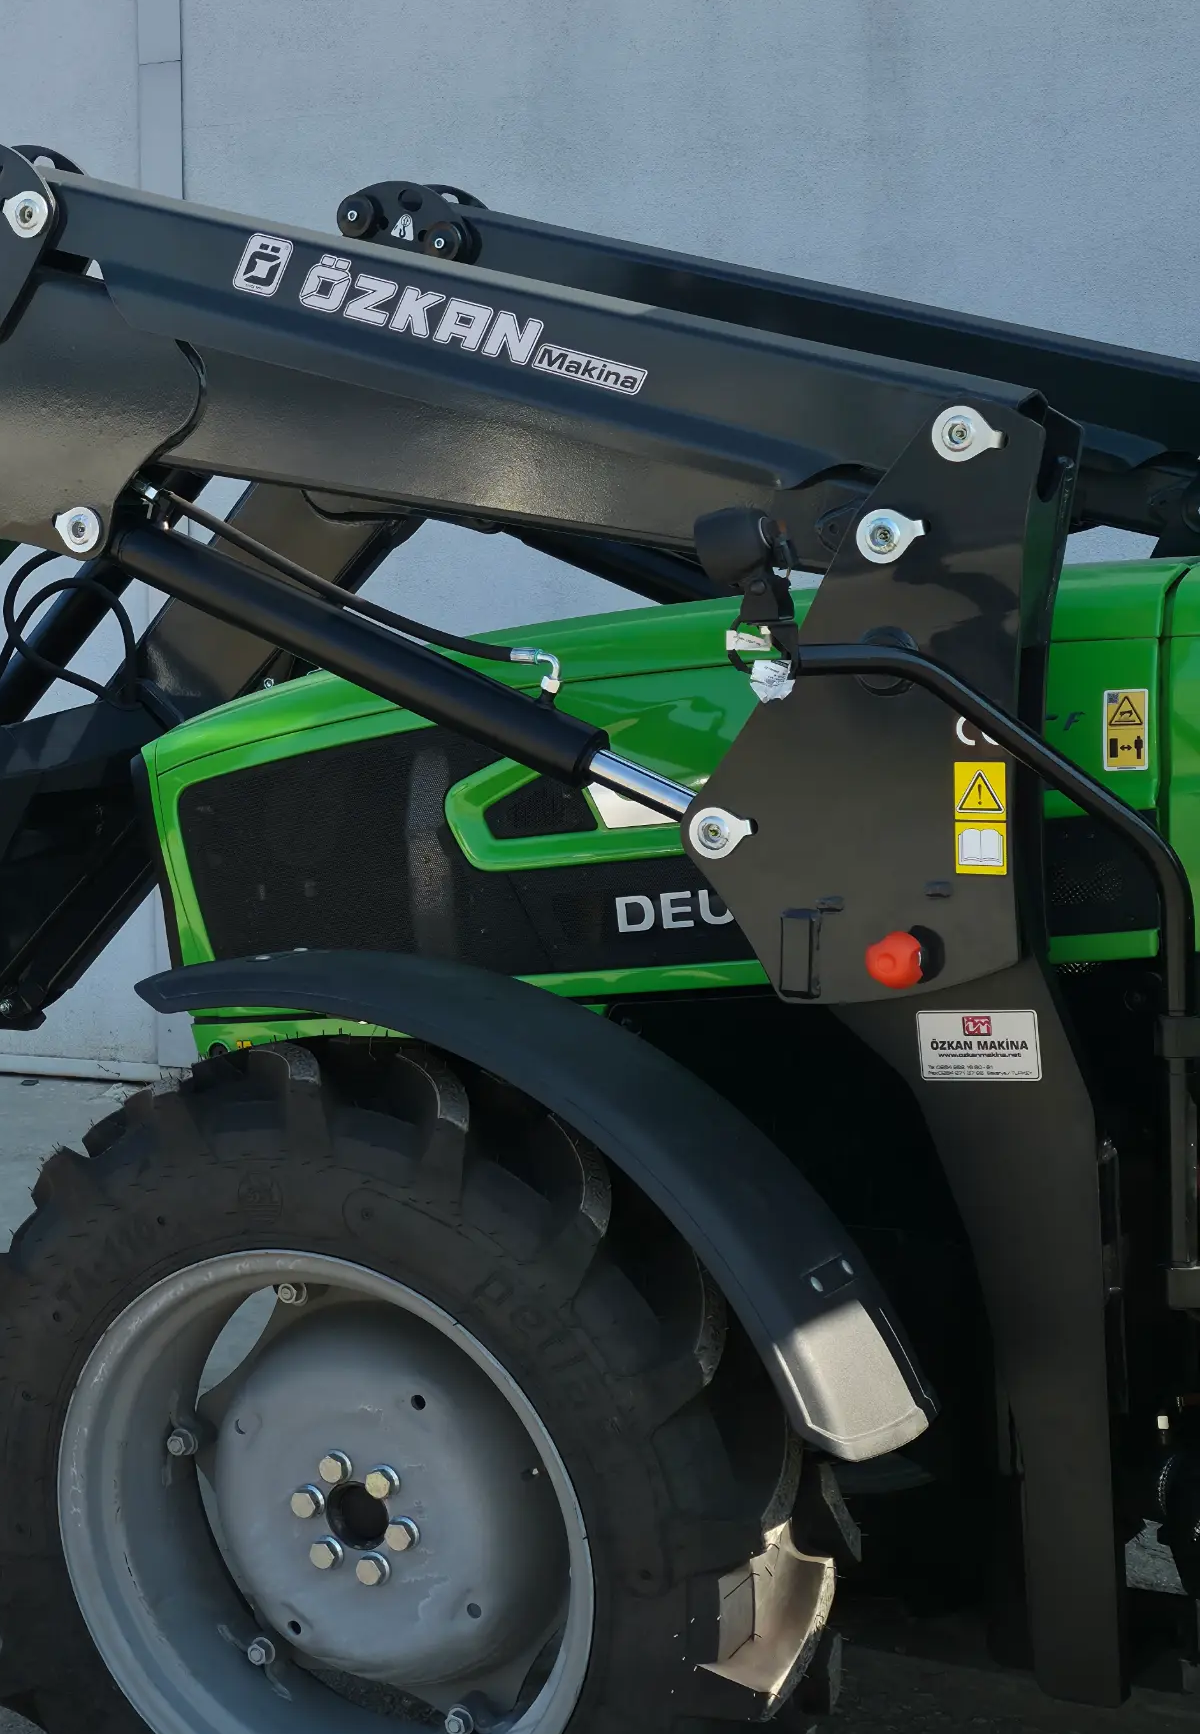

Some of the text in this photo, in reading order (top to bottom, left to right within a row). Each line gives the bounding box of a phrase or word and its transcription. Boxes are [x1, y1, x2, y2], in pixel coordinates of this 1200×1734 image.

[299, 254, 638, 390] ÖZKAN Makina
[956, 716, 1000, 746] C
[930, 1038, 1029, 1051] ÖZKAN MAKİNA
